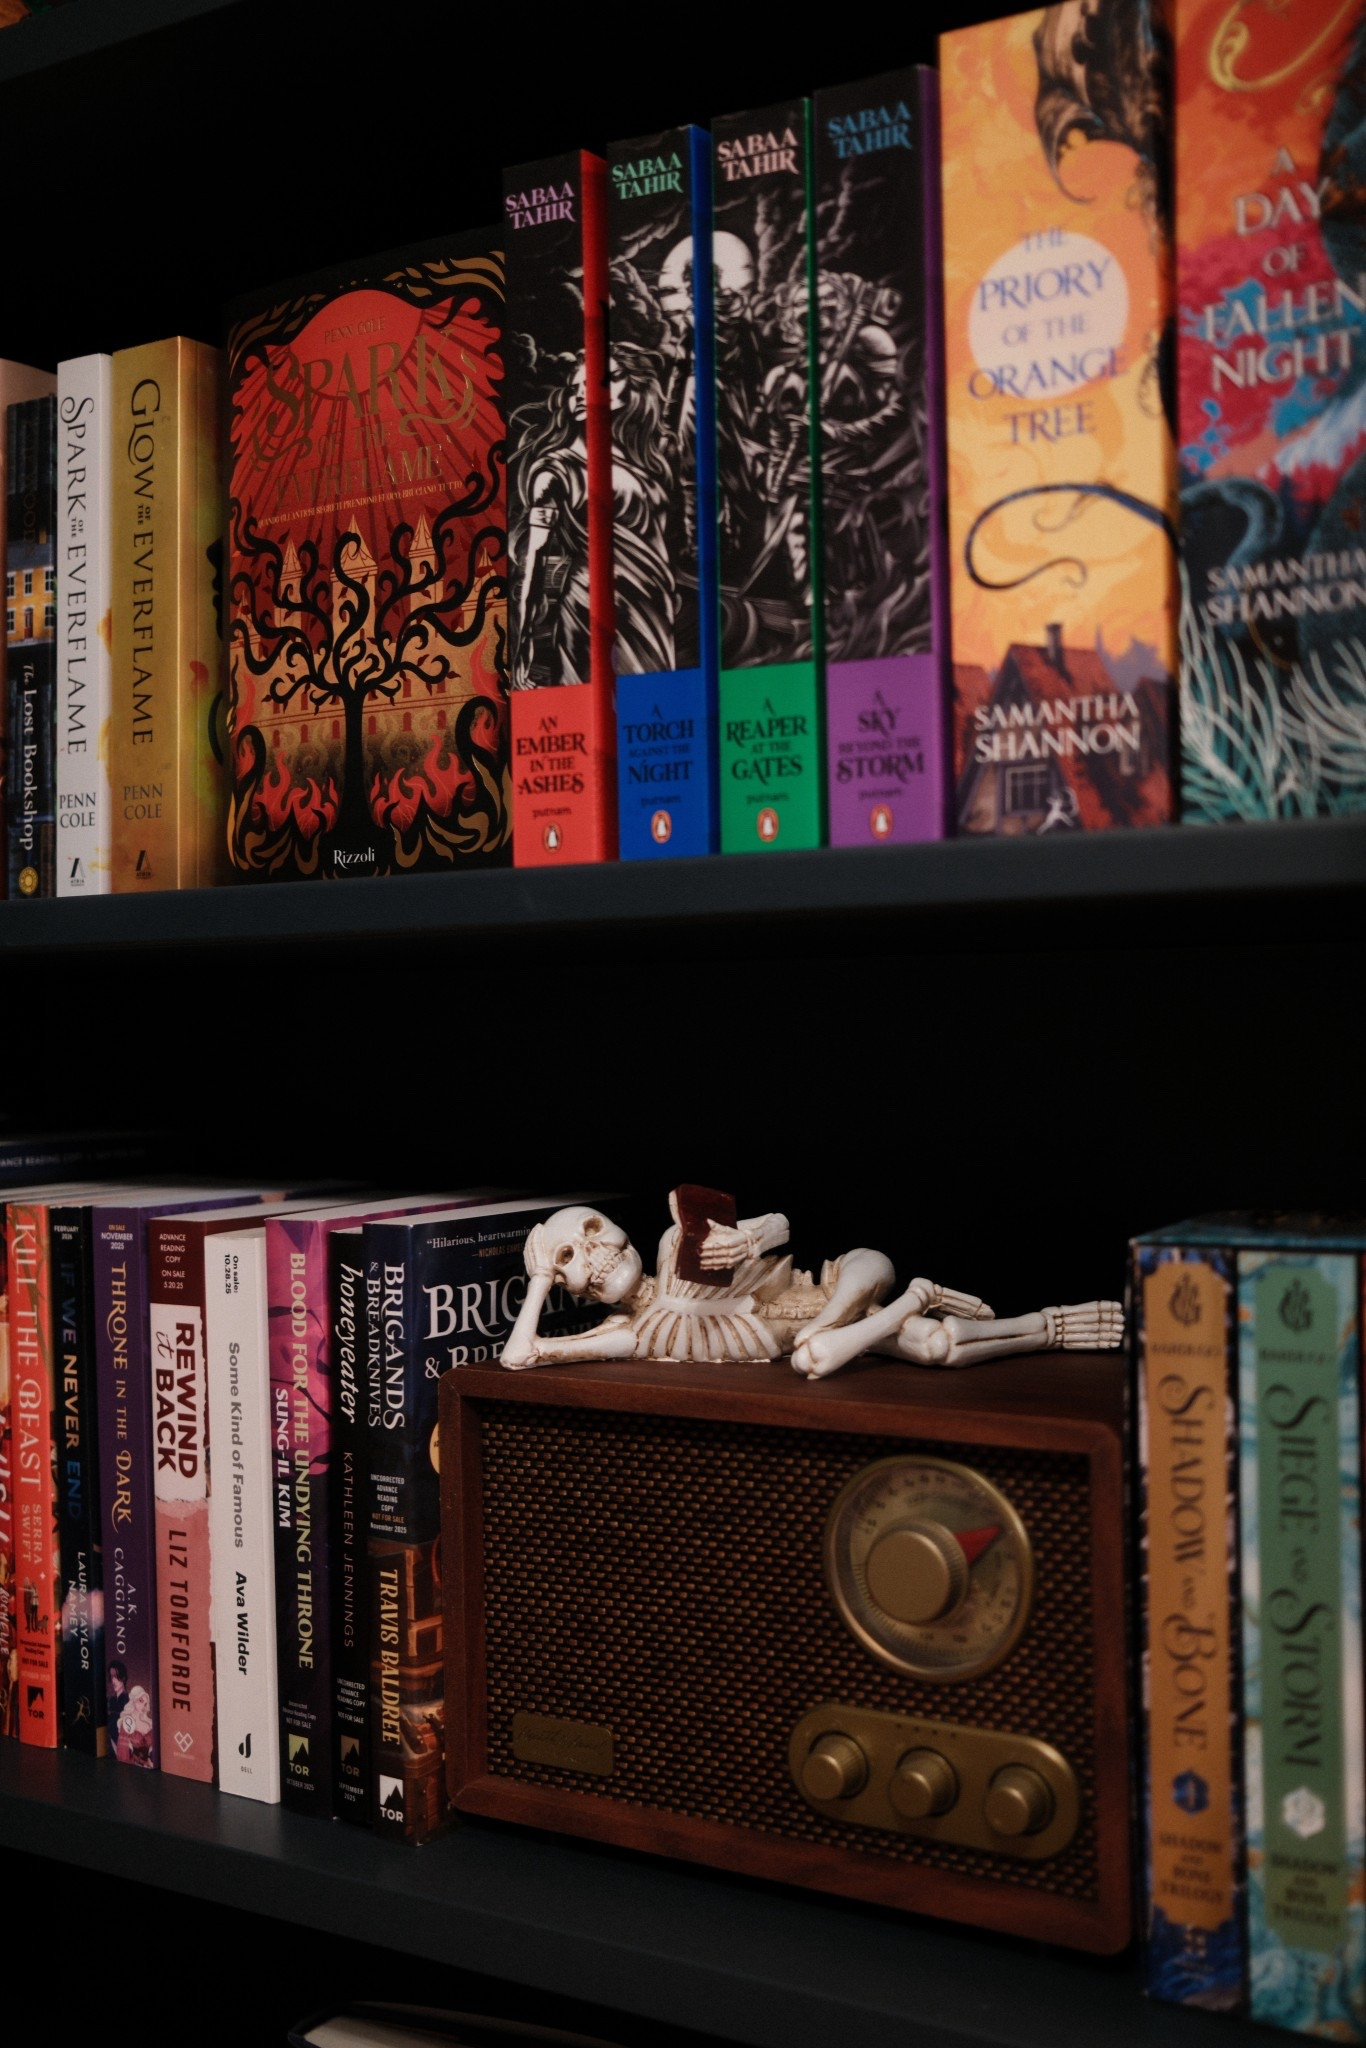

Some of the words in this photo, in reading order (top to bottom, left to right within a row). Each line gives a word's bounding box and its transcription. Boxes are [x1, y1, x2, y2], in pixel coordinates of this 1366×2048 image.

[827, 101, 911, 140] SABAA
[717, 127, 798, 161] SABAA
[832, 124, 912, 160] TAHIR
[1274, 147, 1295, 175] A
[612, 152, 683, 182] SABAA
[721, 149, 799, 181] TAHIR
[506, 181, 575, 212] SABAA
[616, 173, 684, 200] TAHIR
[1235, 177, 1331, 236] DAY
[510, 202, 576, 230] TAHIR
[1263, 246, 1306, 277] OF
[980, 257, 1110, 311] PRIORY
[1204, 272, 1366, 341] FALLEN
[968, 343, 1127, 400] ORANGE
[1210, 325, 1362, 392] NIGHT
[128, 379, 160, 499] GLOW
[1003, 402, 1096, 443] TREE
[60, 396, 94, 516] SPARK
[1207, 546, 1366, 592] SAMANTHA
[1207, 580, 1366, 625] SHANNON
[67, 544, 87, 754] EVERFLAME
[132, 532, 153, 745] EVERFLAME
[22, 689, 38, 736] Lost
[539, 716, 558, 732] AN
[652, 704, 664, 720] A
[857, 708, 899, 737] SKY
[975, 691, 1140, 731] SAMANTHA
[516, 733, 588, 755] EMBER
[624, 718, 694, 745] TORCH
[726, 716, 808, 749] REAPER
[975, 722, 1140, 763] SHANNON
[518, 773, 584, 796] ASHES
[530, 758, 544, 773] IN
[548, 756, 576, 771] THE
[627, 760, 693, 785] NIGHT
[731, 756, 803, 786] GATES
[836, 751, 925, 784] STORM
[19, 744, 38, 850] Bookshop
[59, 792, 96, 809] PENN
[124, 783, 163, 802] PENN
[124, 803, 163, 820] COLE
[532, 806, 572, 818] putnam
[60, 811, 96, 828] COLE
[333, 846, 375, 869] Rizzoli
[53, 1225, 80, 1233] FEBRUARY
[101, 1232, 134, 1241] NOVEMBER
[110, 1242, 125, 1251] 2025
[159, 1233, 186, 1242] ADVANCE
[160, 1244, 186, 1253] READING
[426, 1234, 476, 1249] “Hilarious,
[478, 1226, 532, 1243] heartwarmin
[12, 1224, 37, 1293] KILL
[161, 1270, 171, 1278] ON
[172, 1270, 186, 1278] SALE
[165, 1256, 181, 1264] COPY
[224, 1254, 232, 1294] 10.28.25
[233, 1255, 239, 1269] On
[369, 1261, 379, 1273] &
[163, 1280, 184, 1289] 5.20.25
[290, 1253, 308, 1338] BLOOD
[16, 1304, 39, 1367] THE
[62, 1297, 77, 1344] WE
[107, 1261, 128, 1370] THRONE
[155, 1331, 175, 1360] it
[335, 1262, 363, 1424] honeyeater
[366, 1277, 382, 1428] BREADKNIVES
[380, 1261, 406, 1430] BRIGANDS
[229, 1342, 241, 1397] Some
[292, 1343, 310, 1391] FOR
[424, 1356, 441, 1379] &
[63, 1354, 81, 1450] NEVER
[116, 1379, 127, 1399] IN
[176, 1322, 198, 1479] REWIND
[18, 1377, 42, 1492] BEAST
[117, 1406, 128, 1440] THE
[156, 1368, 177, 1473] BACK
[230, 1401, 243, 1446] Kind
[275, 1388, 291, 1478] SUNG-IL
[294, 1397, 310, 1444] THE
[231, 1449, 244, 1471] of
[1157, 1375, 1214, 1562] SHADOW
[65, 1459, 82, 1521] END
[112, 1449, 132, 1534] DARK
[278, 1483, 292, 1529] KIM
[294, 1449, 313, 1564] UNDYING
[344, 1451, 355, 1546] KATHLEEN
[232, 1473, 245, 1549] Famous
[21, 1503, 32, 1562] SWIFT
[32, 1503, 43, 1565] SERA
[169, 1530, 188, 1569] LIZ
[78, 1551, 88, 1603] LAURA
[235, 1571, 248, 1607] Ava
[114, 1547, 127, 1655] CAGGIANO
[127, 1584, 137, 1621] A.K.
[344, 1551, 355, 1648] JENNINGS
[379, 1568, 400, 1645] TRAVIS
[296, 1570, 315, 1670] THRONE
[80, 1610, 90, 1671] TAYLOR
[170, 1580, 195, 1712] TOMFORDE
[236, 1612, 250, 1676] Wilder
[380, 1649, 401, 1746] BALDREE
[1162, 1613, 1217, 1751] BONE
[1270, 1588, 1337, 1767] STORM
[28, 1708, 45, 1719] TOR
[288, 1761, 310, 1777] TOR
[340, 1762, 360, 1777] TOR
[379, 1806, 404, 1823] TOR
